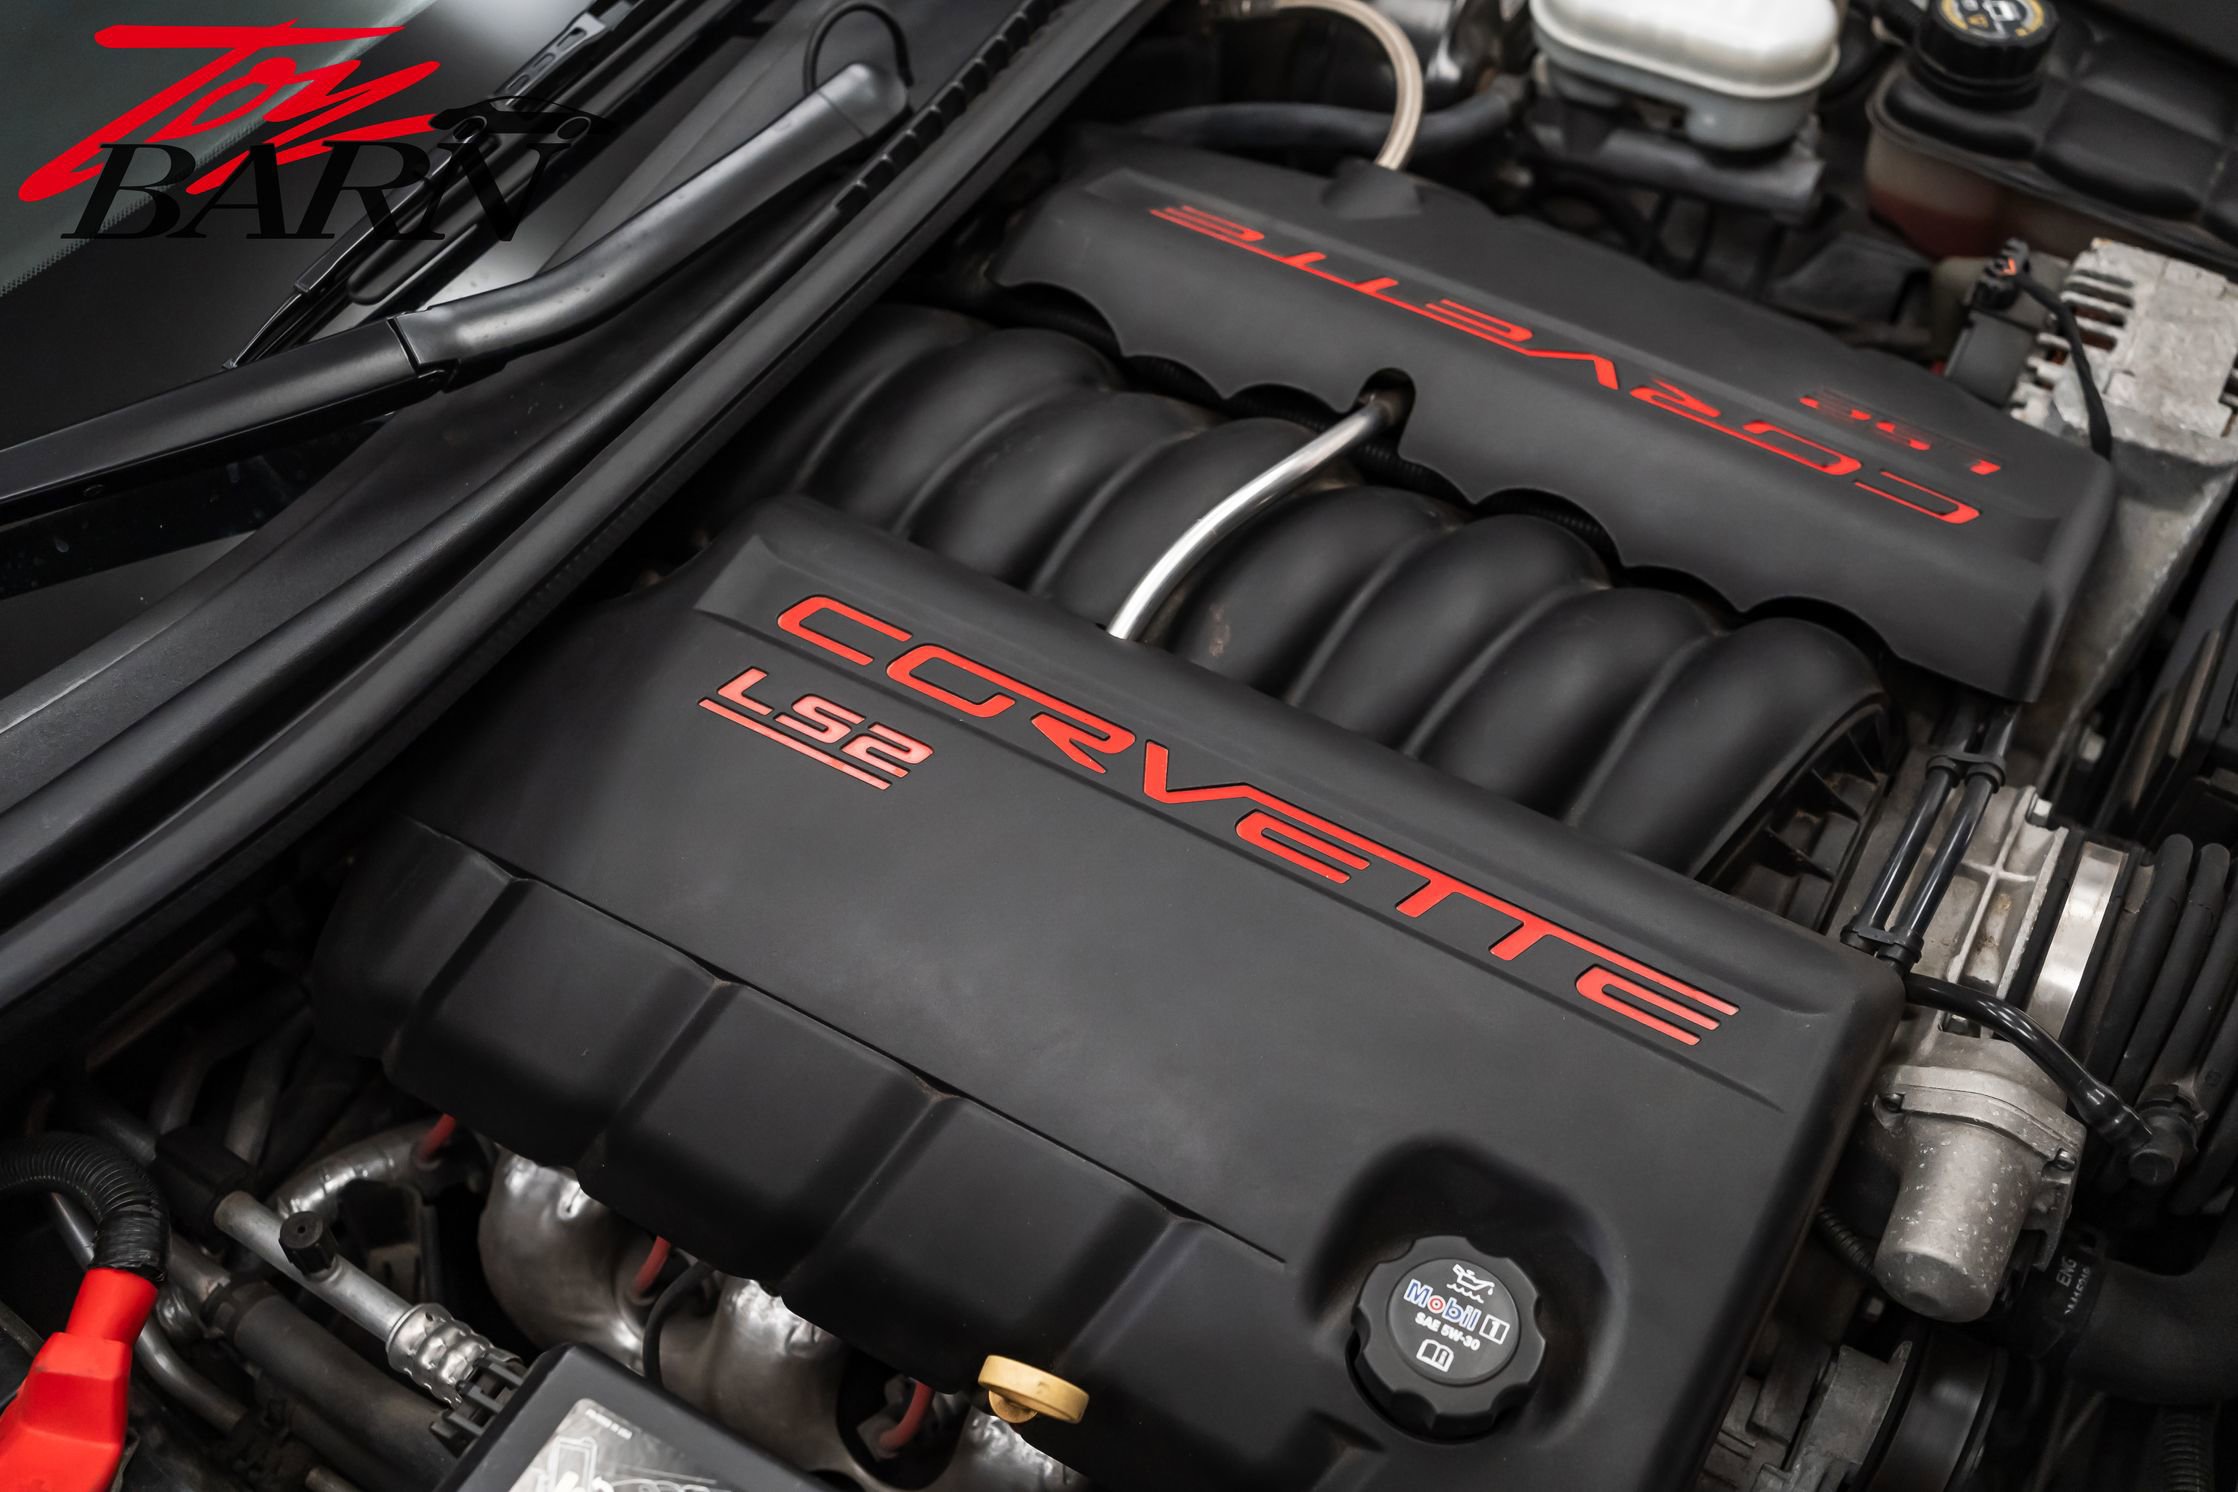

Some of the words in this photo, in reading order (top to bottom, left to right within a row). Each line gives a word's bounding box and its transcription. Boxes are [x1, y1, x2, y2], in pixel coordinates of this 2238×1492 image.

[1150, 204, 1981, 524] CORVETTE
[717, 666, 934, 778] LS2
[777, 594, 1738, 1044] CORVETTE
[1403, 1278, 1481, 1332] Mobil
[2056, 1256, 2077, 1287] ENG
[1415, 1312, 1441, 1332] SAE
[1440, 1324, 1481, 1351] 5W-30
